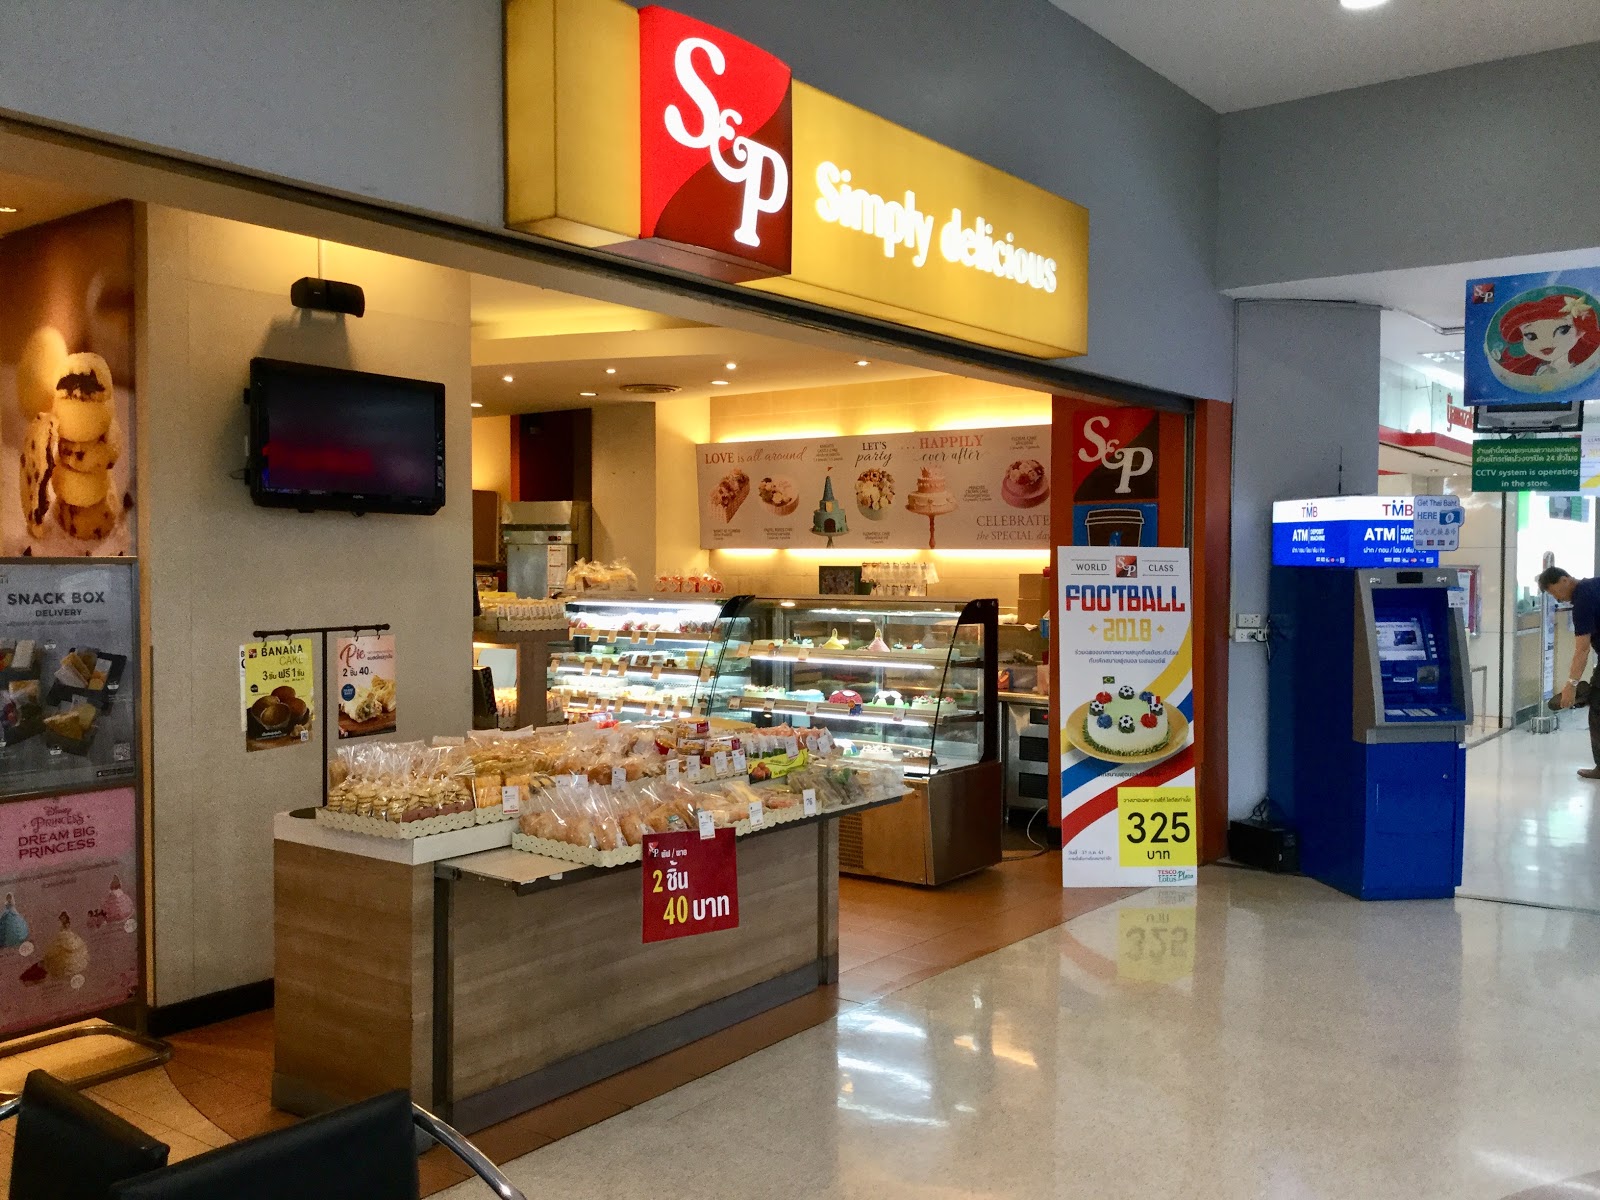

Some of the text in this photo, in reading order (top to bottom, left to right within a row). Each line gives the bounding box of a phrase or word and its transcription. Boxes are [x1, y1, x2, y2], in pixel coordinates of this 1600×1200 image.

[664, 37, 789, 247] S&P
[815, 160, 1058, 293] Simply delicious
[862, 441, 887, 451] LET'S
[919, 435, 984, 449] HAPPILY
[705, 453, 735, 465] LOVE
[764, 446, 808, 462] around
[854, 451, 893, 467] party
[951, 447, 982, 465] after
[1078, 416, 1154, 493] S&P
[1475, 467, 1579, 479] CCTV system is operating
[1511, 479, 1525, 487] the
[1301, 503, 1318, 517] TMB
[1382, 500, 1414, 517] TMB
[976, 514, 1050, 527] CELEBRATE
[1417, 512, 1437, 520] HERE
[976, 530, 989, 541] the
[991, 530, 1033, 541] SPECIAL
[1292, 528, 1309, 541] ATM
[1364, 528, 1396, 541] ATM
[1076, 563, 1108, 571] WORLD
[1148, 564, 1174, 572] CLASS
[7, 591, 105, 606] SNACK BOX
[1065, 584, 1186, 612] FOOTBALL
[35, 608, 82, 618] DELIVERY
[1103, 618, 1152, 642] 2018
[261, 643, 304, 657] BANANA
[339, 643, 366, 667] Pie
[262, 670, 268, 681] 3
[278, 667, 291, 679] ฟรี
[291, 667, 296, 677] 1
[342, 668, 348, 677] 2
[1126, 812, 1190, 844] 325
[18, 828, 70, 847] DREAM
[1147, 850, 1171, 860] บาท
[652, 860, 689, 893] 2 ชิ้น
[662, 895, 730, 925] 40 บาท
